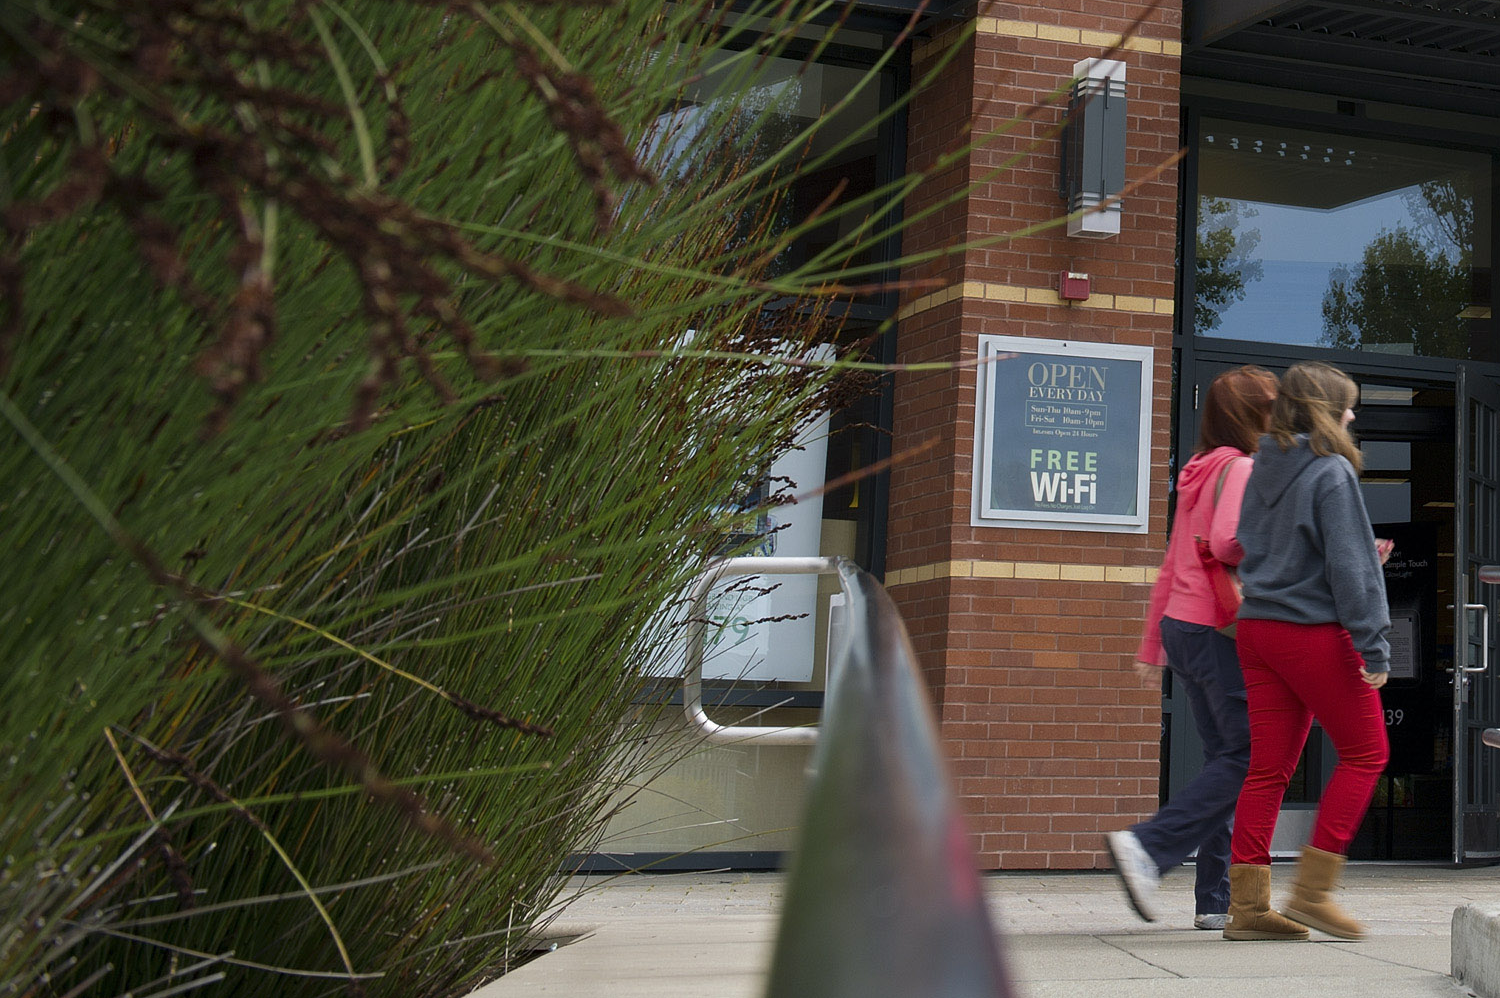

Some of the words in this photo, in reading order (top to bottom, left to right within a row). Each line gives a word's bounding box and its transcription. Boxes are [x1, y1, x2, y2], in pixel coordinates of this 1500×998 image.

[1028, 362, 1109, 390] OPEN
[1029, 387, 1075, 400] EVERY
[1077, 389, 1106, 402] DAY
[1030, 449, 1097, 472] FREE
[1030, 472, 1097, 505] Wi-Fi
[1408, 559, 1428, 568] Touch
